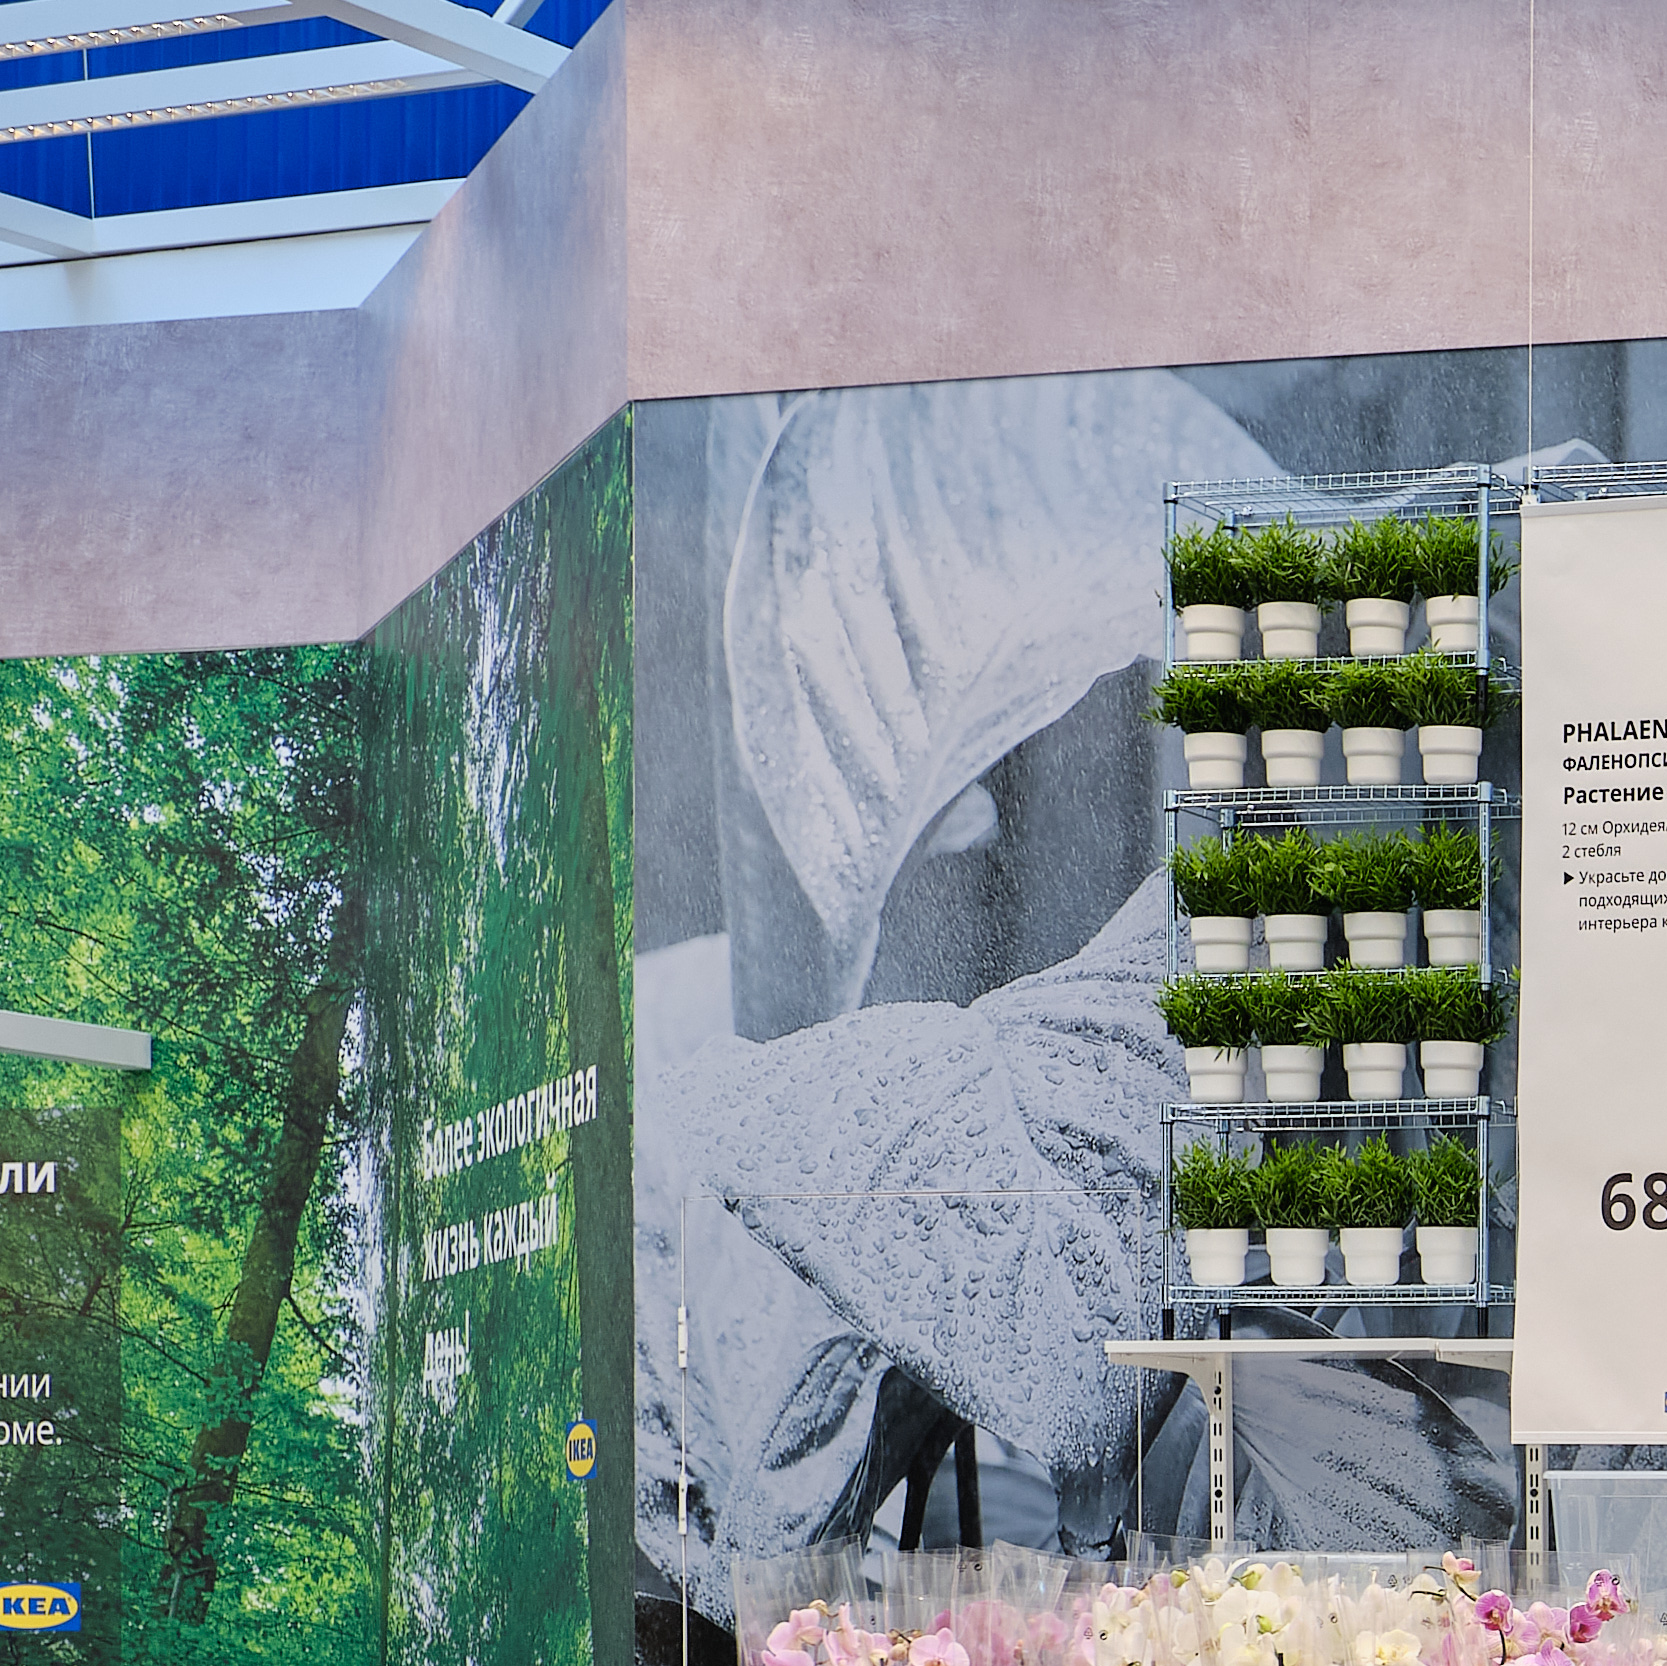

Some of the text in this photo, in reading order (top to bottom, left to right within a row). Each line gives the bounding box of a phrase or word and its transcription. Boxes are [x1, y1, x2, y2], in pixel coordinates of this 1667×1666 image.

[1564, 787, 1663, 804] Растение
[1563, 823, 1576, 835] 12
[1581, 825, 1597, 835] см
[1563, 843, 1620, 858] 2 стебля
[1579, 872, 1644, 887] Украсьте
[1579, 918, 1657, 933] интерьера
[423, 1065, 597, 1181] Более экологичная
[423, 1173, 559, 1282] жизнь каждый
[423, 1310, 471, 1398] день!
[568, 1432, 594, 1462] IKEA
